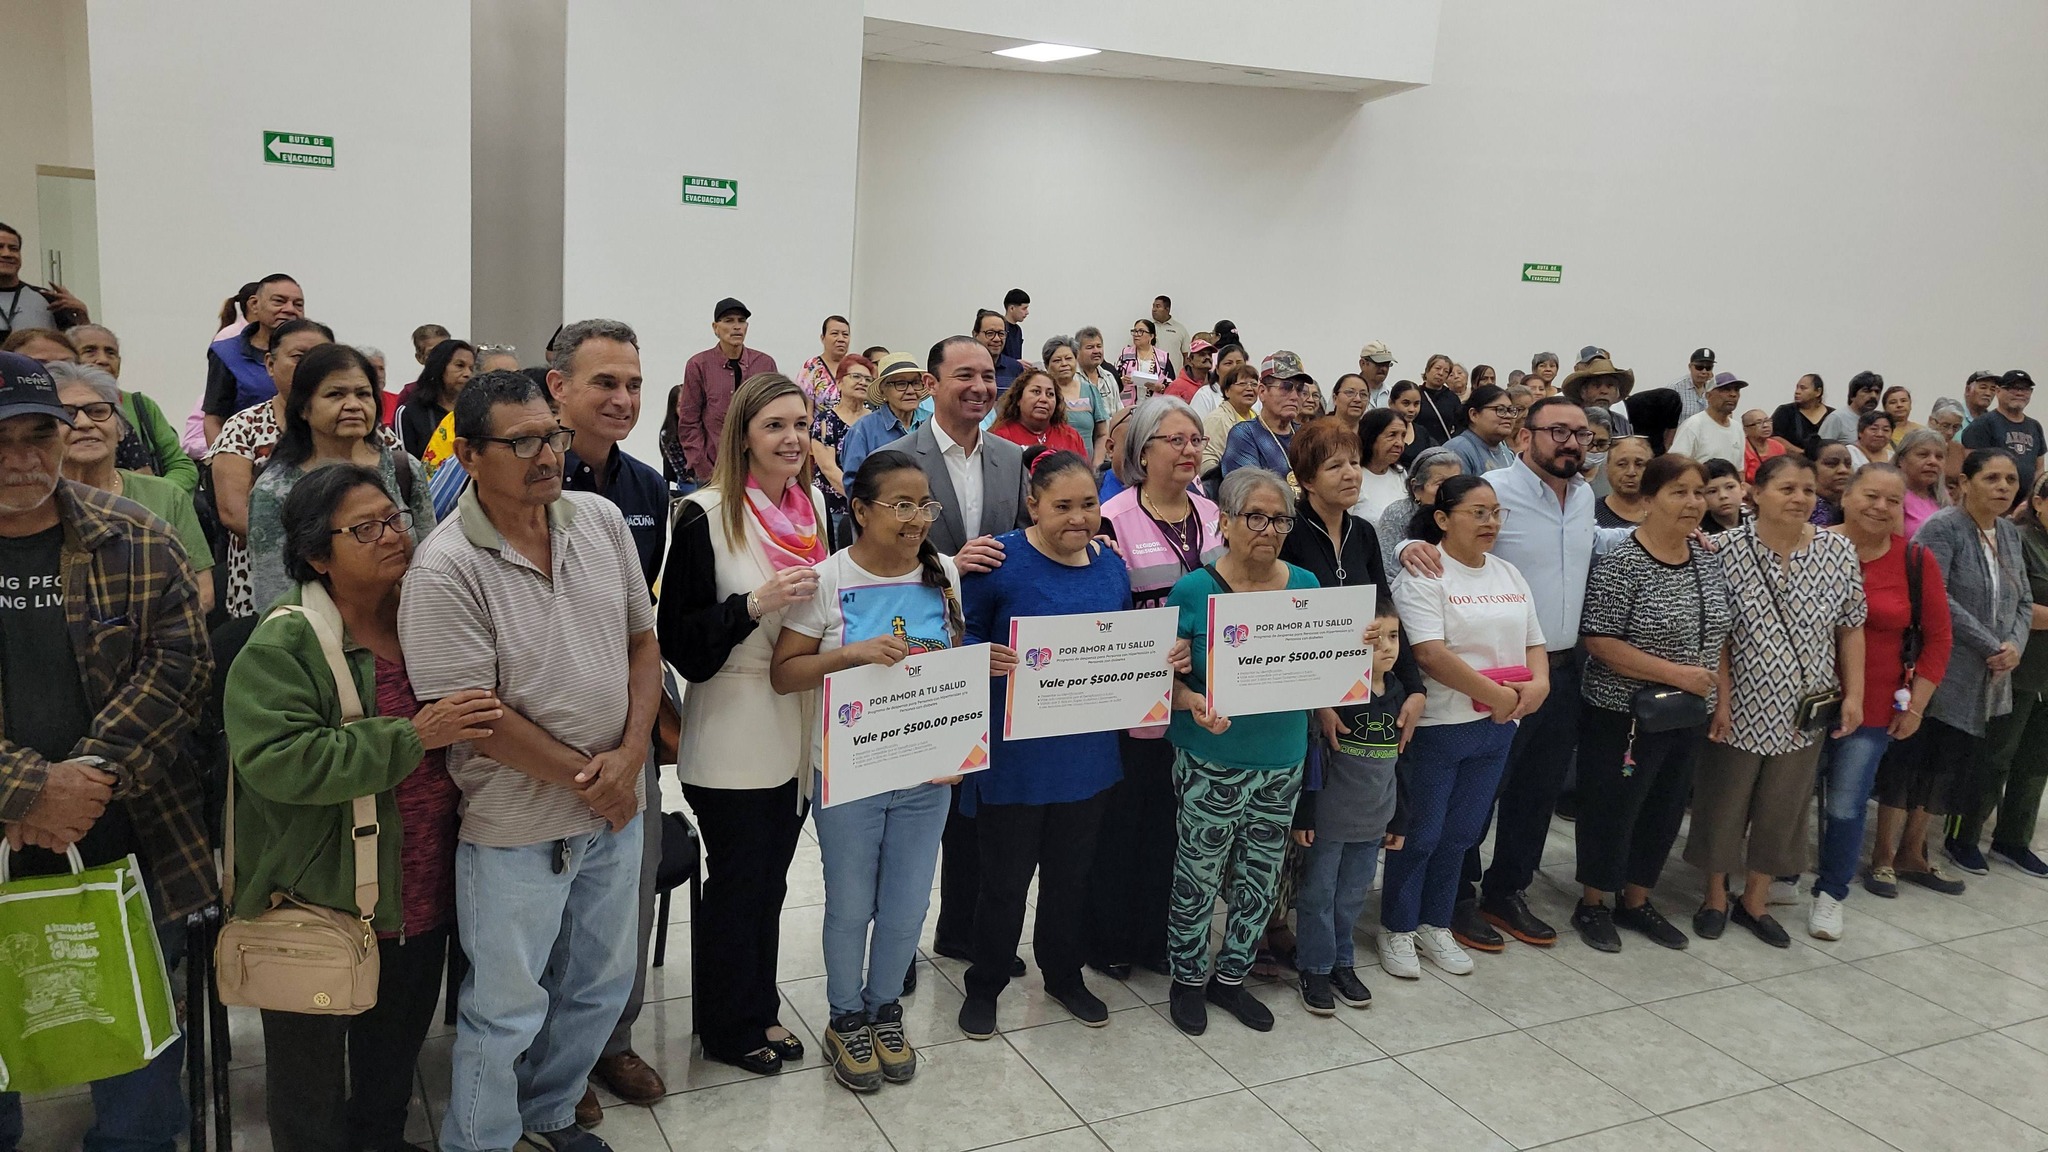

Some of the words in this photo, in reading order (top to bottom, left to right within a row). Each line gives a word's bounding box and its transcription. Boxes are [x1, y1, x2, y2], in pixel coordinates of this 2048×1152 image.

[288, 136, 310, 144] RUTA
[282, 154, 332, 165] EVACUACION
[685, 195, 724, 204] EVACUACION
[842, 593, 855, 603] 47
[1296, 600, 1309, 608] DIF
[1100, 622, 1113, 631] DIF
[1276, 622, 1302, 630] AMOR
[1080, 645, 1105, 653] AMOR
[1128, 641, 1154, 649] SALUD
[1238, 657, 1262, 666] Vale
[1266, 654, 1286, 666] por
[1288, 650, 1332, 663] $500.00
[1335, 648, 1367, 661] pesos
[909, 666, 922, 676] DIF
[1039, 679, 1064, 689] Vale
[1067, 676, 1087, 688] por
[1090, 671, 1133, 685] $500.00
[1136, 669, 1168, 682] pesos
[870, 696, 887, 706] POR
[890, 690, 916, 702] AMOR
[927, 686, 937, 694] TU
[940, 680, 966, 692] SALUD
[853, 732, 877, 746] Vale
[881, 729, 900, 743] por
[903, 716, 948, 735] $500.00
[950, 710, 983, 726] pesos
